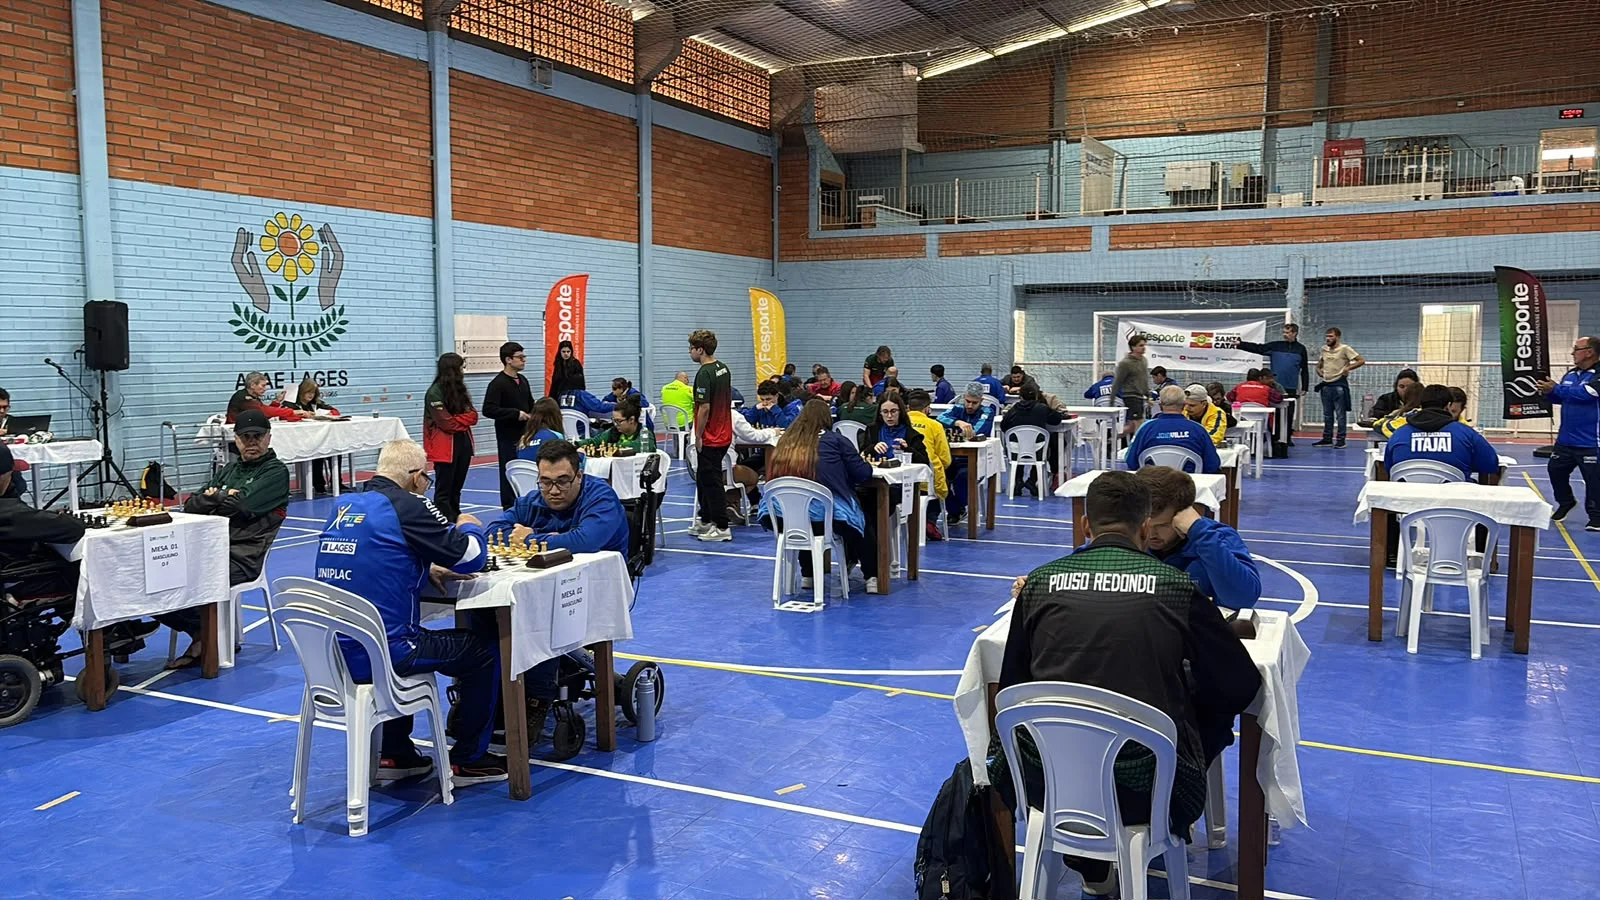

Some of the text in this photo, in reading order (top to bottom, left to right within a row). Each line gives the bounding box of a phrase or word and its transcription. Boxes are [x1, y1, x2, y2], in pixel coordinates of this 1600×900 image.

[557, 284, 575, 342] sporte
[757, 297, 772, 362] Fesporte
[1511, 283, 1534, 371] Fesporte
[235, 372, 285, 390] AAE
[1411, 437, 1452, 452] ITAJAI
[152, 552, 178, 560] MASCULINO
[329, 543, 354, 553] LAGES
[318, 567, 352, 581] UNIPLAC
[1049, 572, 1157, 595] POUSO REDONDO
[561, 589, 575, 599] MESA
